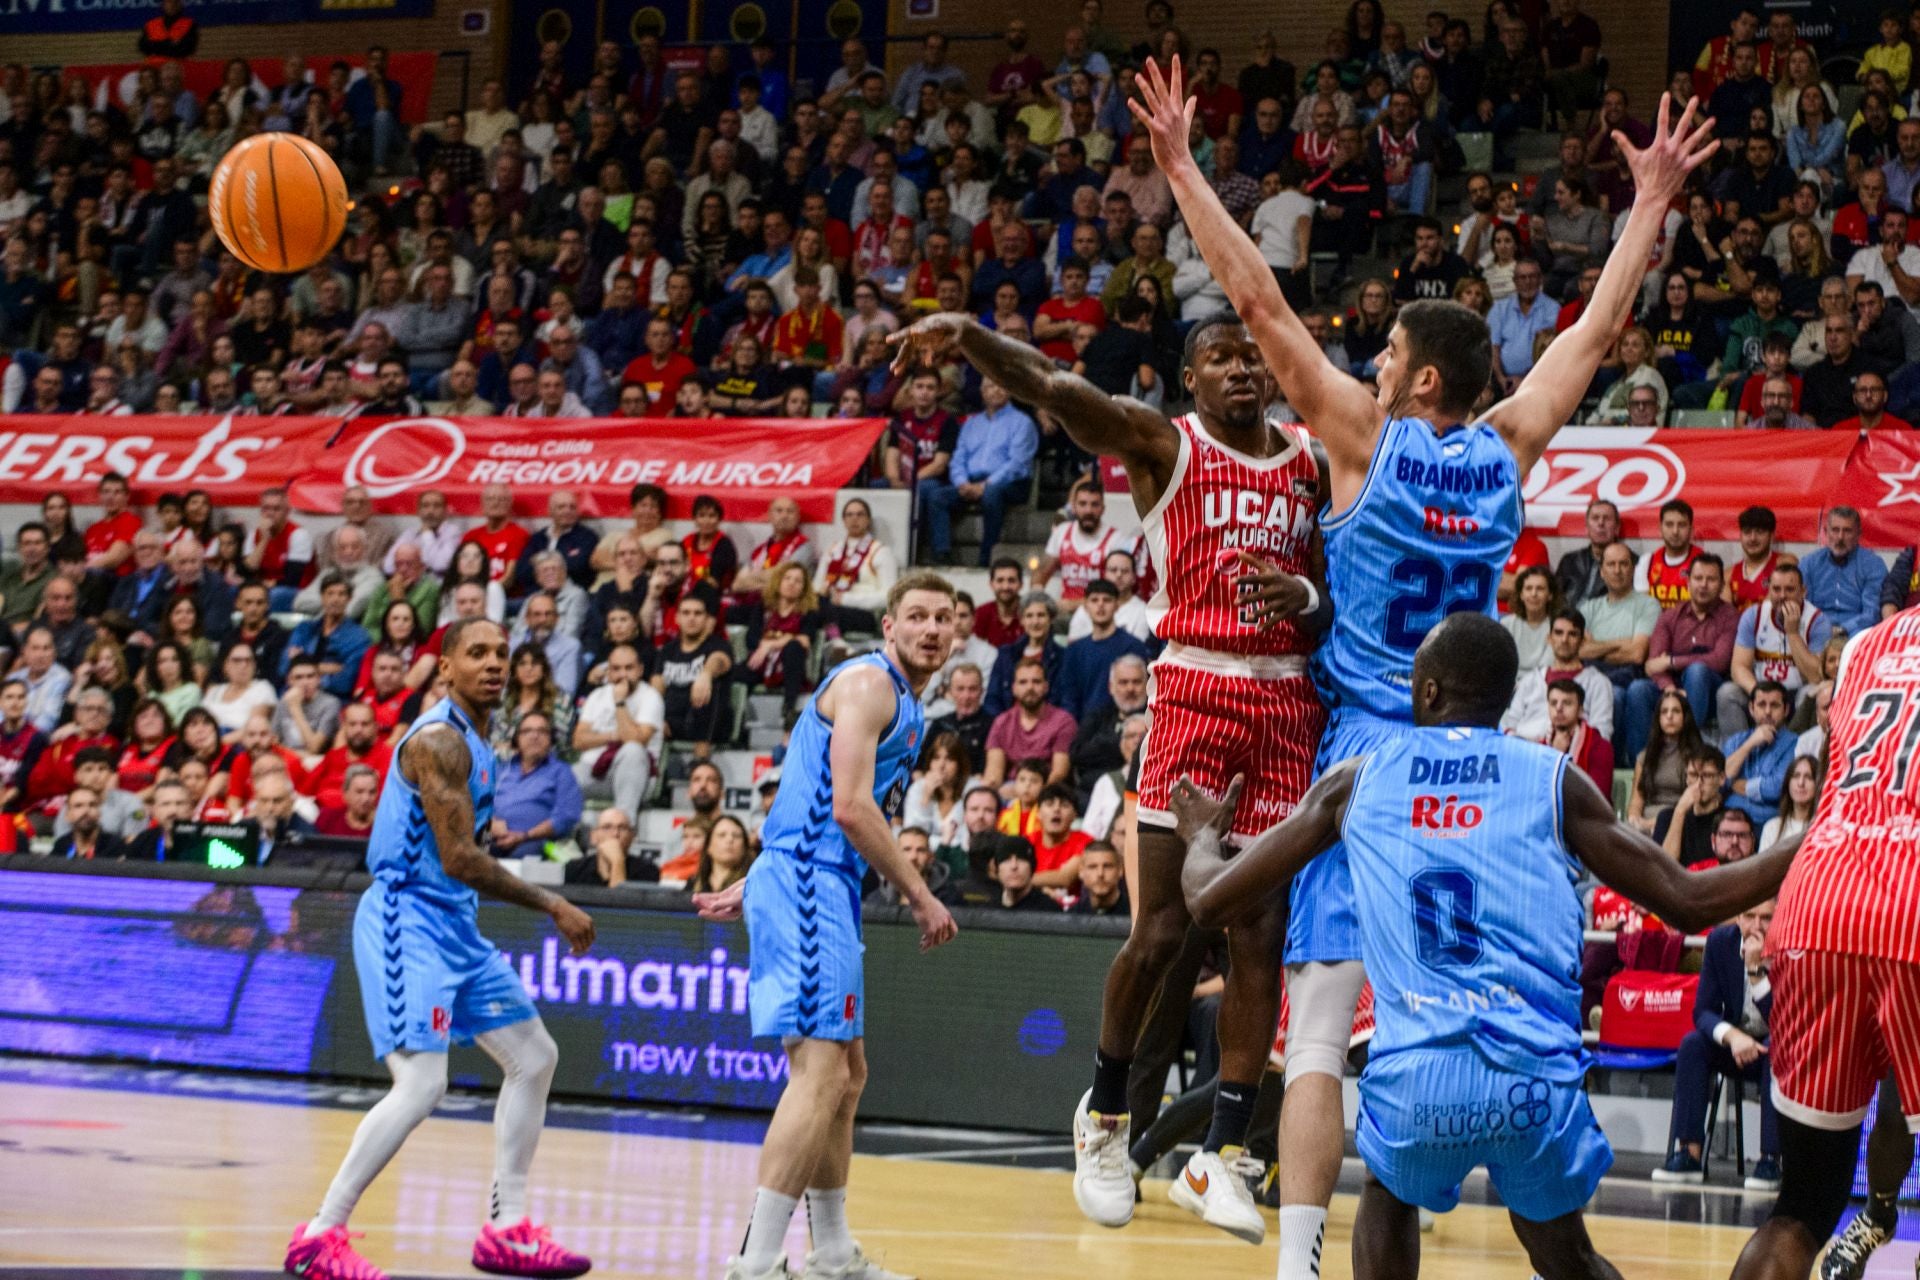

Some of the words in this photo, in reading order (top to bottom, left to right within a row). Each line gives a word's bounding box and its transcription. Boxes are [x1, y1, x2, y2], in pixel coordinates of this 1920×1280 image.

[468, 457, 610, 484] REGIÓN
[609, 460, 667, 484] DE
[667, 462, 814, 486] MURCIA
[1204, 490, 1315, 547] UCAM
[1222, 528, 1296, 559] MURCIA
[1381, 557, 1494, 648] 22
[1408, 753, 1501, 786] DIBBA
[1410, 794, 1484, 830] Río
[1409, 866, 1484, 972] 0
[610, 1041, 698, 1076] new
[705, 1041, 790, 1082] trav
[1435, 1108, 1504, 1137] LUGO
